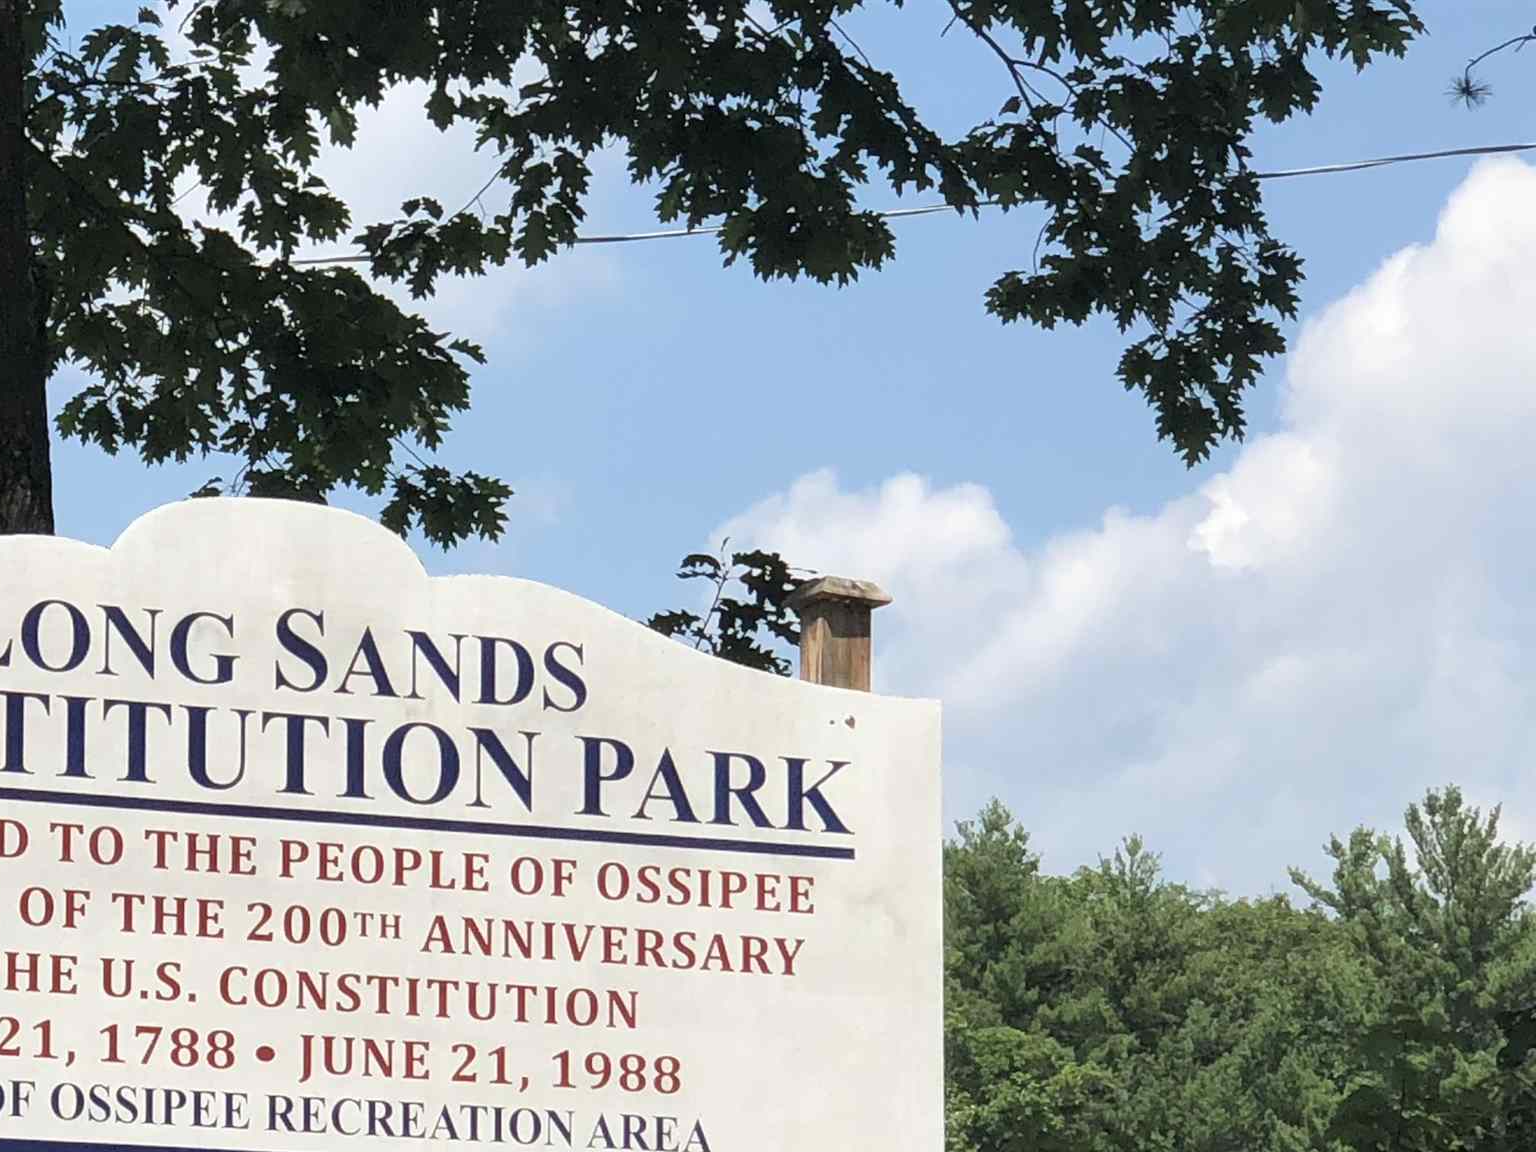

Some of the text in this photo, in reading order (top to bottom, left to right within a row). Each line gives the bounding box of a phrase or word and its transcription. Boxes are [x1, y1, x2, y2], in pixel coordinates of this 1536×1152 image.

[276, 609, 586, 712] SANDS
[575, 736, 854, 834] PARK
[50, 823, 123, 864] TO
[145, 830, 256, 875] THE
[280, 840, 489, 891] PEOPLE
[511, 857, 576, 896] OF
[598, 863, 813, 913] OSSIPEE
[20, 887, 90, 928] OF
[112, 893, 223, 938] THE
[422, 916, 804, 975] ANNIVERSARY
[101, 958, 195, 1001] U.S.
[220, 967, 637, 1028] CONSTITUTION
[101, 1024, 234, 1069] 1788
[300, 1035, 429, 1082] JUNE
[452, 1044, 528, 1092] 21,
[553, 1051, 680, 1093] 1988
[51, 1083, 248, 1128] OSSIPEE
[266, 1096, 574, 1146] RECREATION
[587, 1114, 712, 1152] AREA
